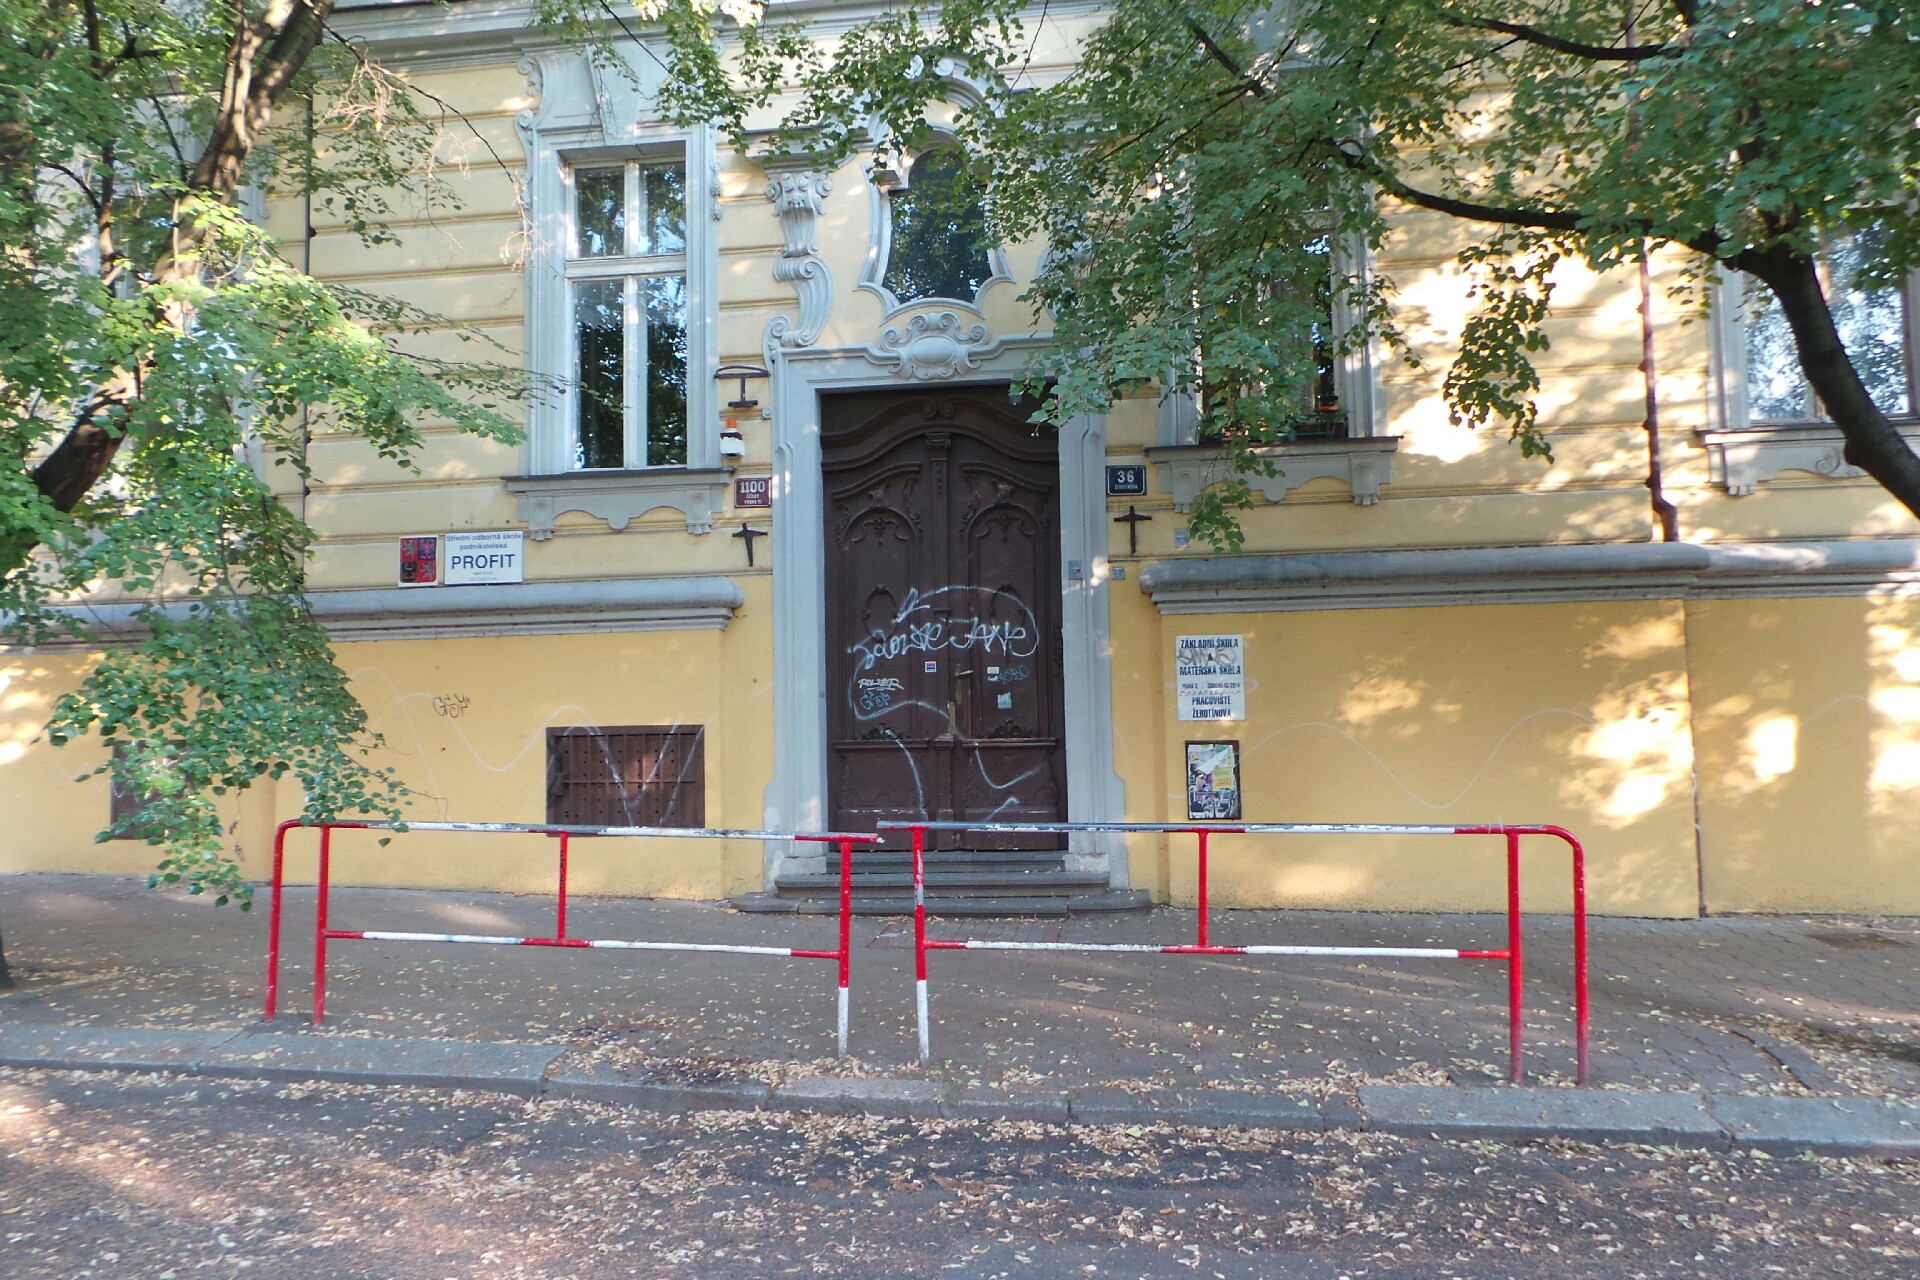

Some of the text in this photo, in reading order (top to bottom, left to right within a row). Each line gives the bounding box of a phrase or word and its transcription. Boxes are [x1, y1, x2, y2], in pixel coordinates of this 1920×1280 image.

[1117, 470, 1135, 483] 36
[740, 481, 765, 493] 1100
[446, 532, 522, 542] Střední odborná škola
[451, 554, 516, 570] PROFIT
[1181, 637, 1239, 649] ZÁKLADNÍ ŠKOLA
[1208, 653, 1213, 661] A
[1180, 665, 1241, 675] MATEŘSKÁ ŠKOLA
[1192, 695, 1231, 706] PRACOVIŠTĚ
[1192, 707, 1232, 718] ŽEROTÍNOVA
